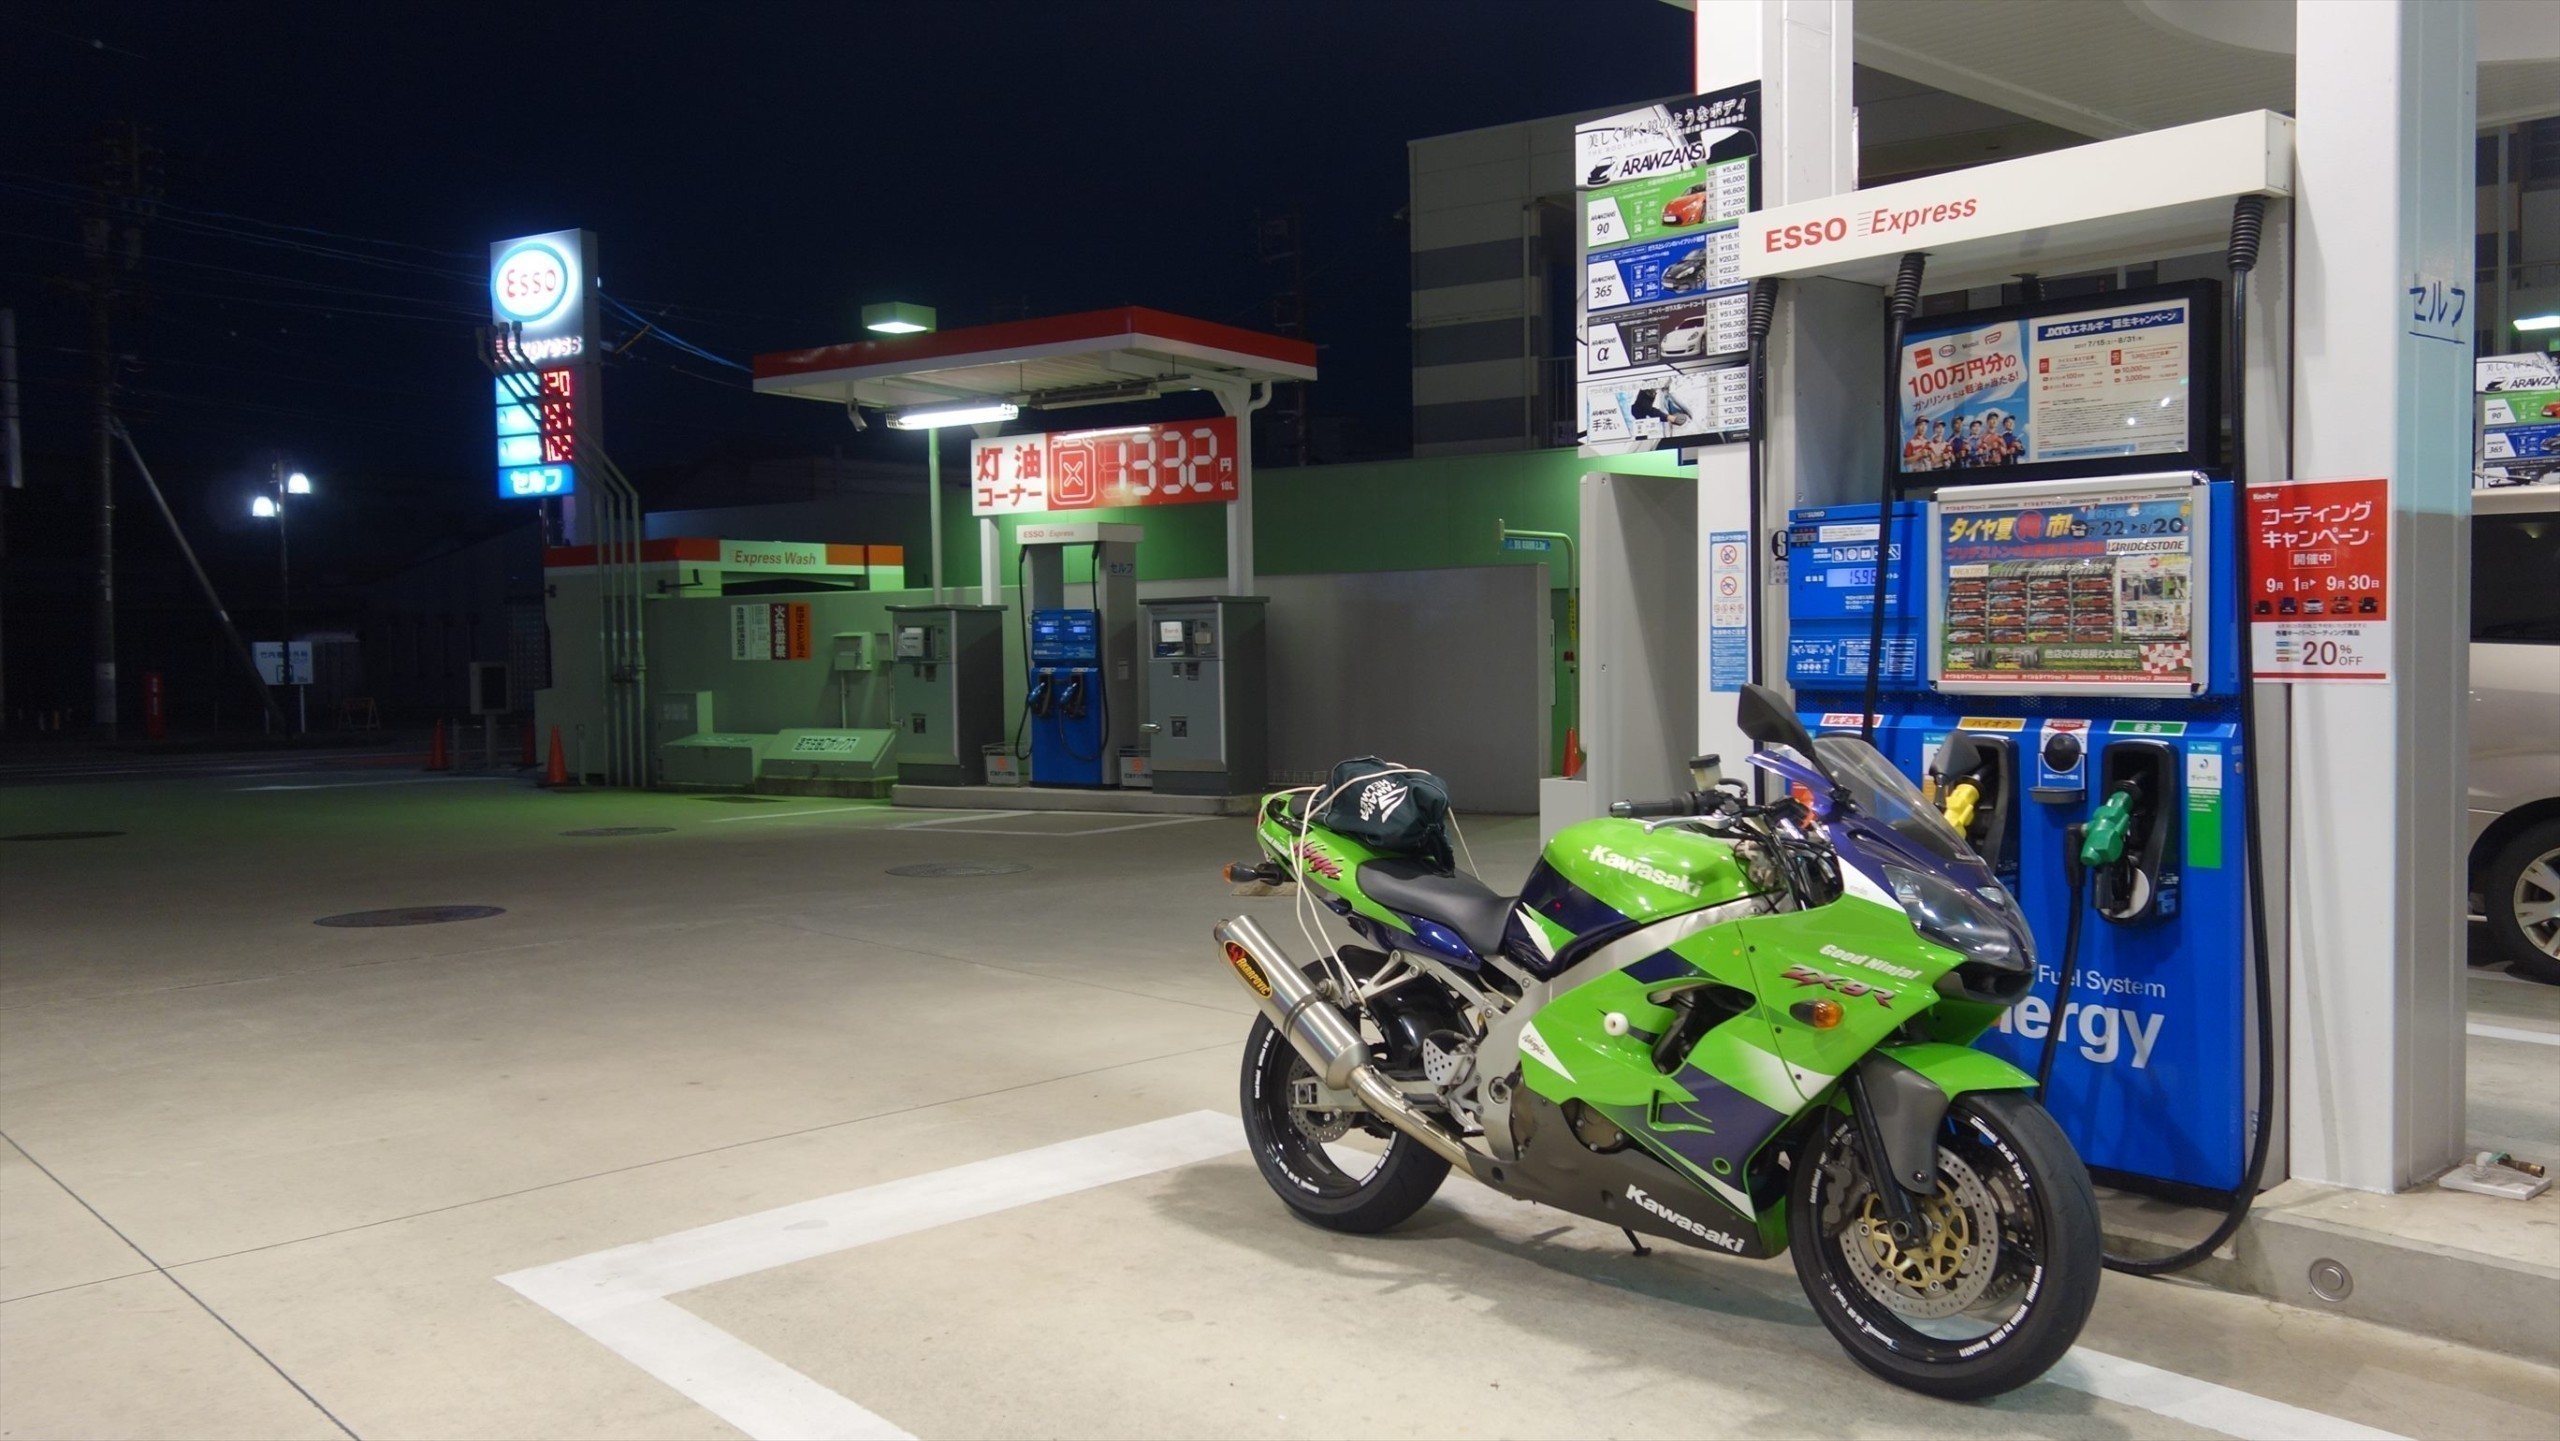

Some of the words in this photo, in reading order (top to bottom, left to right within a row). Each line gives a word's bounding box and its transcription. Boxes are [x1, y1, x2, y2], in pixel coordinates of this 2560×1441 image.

[1588, 98, 1747, 148] 美しく輝く鏡のようなボディ
[1620, 142, 1703, 177] ARAWZANS
[1596, 222, 1610, 236] 90
[1766, 217, 1848, 253] ESSO
[1871, 197, 1977, 235] Express
[1594, 286, 1613, 299] 365
[2409, 280, 2466, 328] セルフ
[1908, 352, 2017, 398] 100万円分の
[1592, 418, 1620, 433] 手洗い
[2491, 411, 2502, 420] 90
[2489, 445, 2503, 454] 365
[976, 443, 1042, 482] 灯油
[510, 468, 563, 494] セルフ
[977, 484, 1043, 507] コーナー
[2261, 501, 2372, 526] コーティング
[1023, 530, 1045, 539] ESSO
[1049, 529, 1075, 538] Express
[2262, 529, 2370, 549] キャンペーン
[734, 549, 783, 567] Express
[784, 550, 818, 567] Wash
[1109, 563, 1135, 575] セルフ
[2293, 553, 2332, 567] 開催中
[2266, 578, 2284, 593] 9月
[2292, 576, 2309, 592] 1日
[2326, 575, 2345, 591] 9月
[2348, 575, 2380, 591] 30日
[775, 605, 786, 659] 火気厳禁
[2302, 640, 2338, 666] 20
[2339, 644, 2352, 655] %
[2339, 656, 2363, 666] OFF
[1971, 719, 2013, 729] ハイオク
[1588, 843, 1705, 899] Kawasaki
[1819, 943, 1868, 970] Good
[1867, 953, 1925, 981] Ninja!
[2086, 970, 2167, 999] System
[1521, 1032, 1549, 1058] Ninja
[1625, 1182, 1744, 1254] Kawasaki
